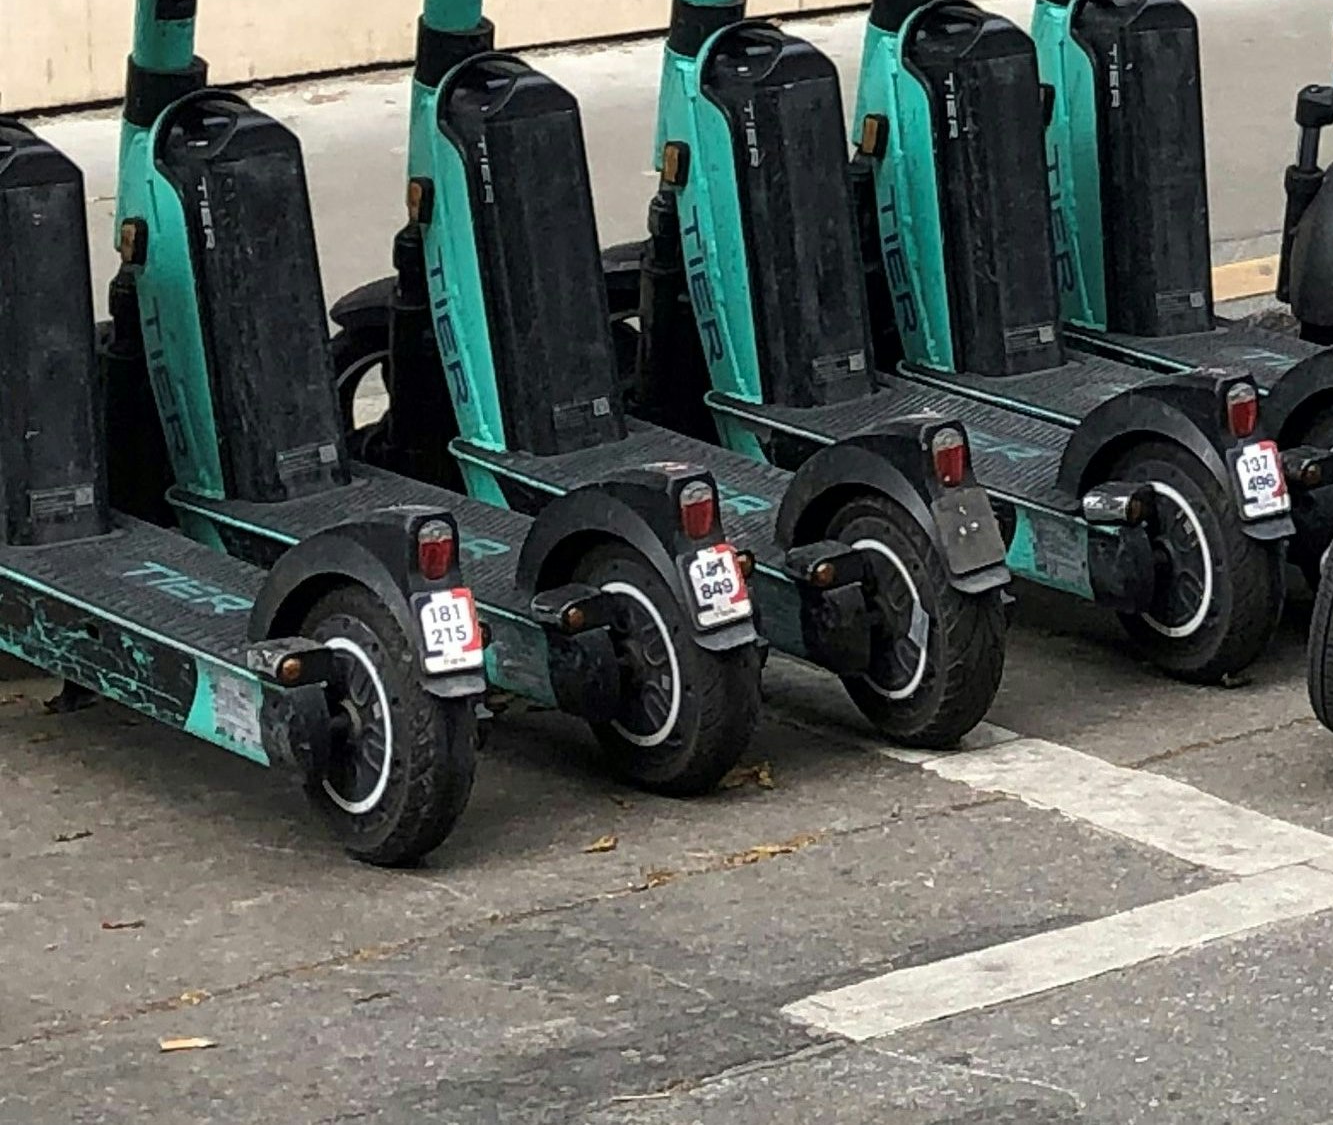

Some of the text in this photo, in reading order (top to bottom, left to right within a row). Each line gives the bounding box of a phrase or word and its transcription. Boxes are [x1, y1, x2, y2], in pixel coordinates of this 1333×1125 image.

[943, 72, 959, 139] TIER
[1107, 43, 1121, 108] TIER
[743, 99, 761, 168] TIER
[477, 134, 495, 204] TIER
[197, 176, 216, 250] TIER
[1046, 143, 1074, 293] TIER
[684, 205, 724, 366] TIER
[880, 183, 918, 333] TIER
[429, 245, 470, 405] TIER
[145, 295, 188, 458] TIER
[122, 560, 256, 615] TIER
[428, 603, 461, 624] 181
[700, 577, 733, 600] 849
[431, 624, 467, 646] 215
